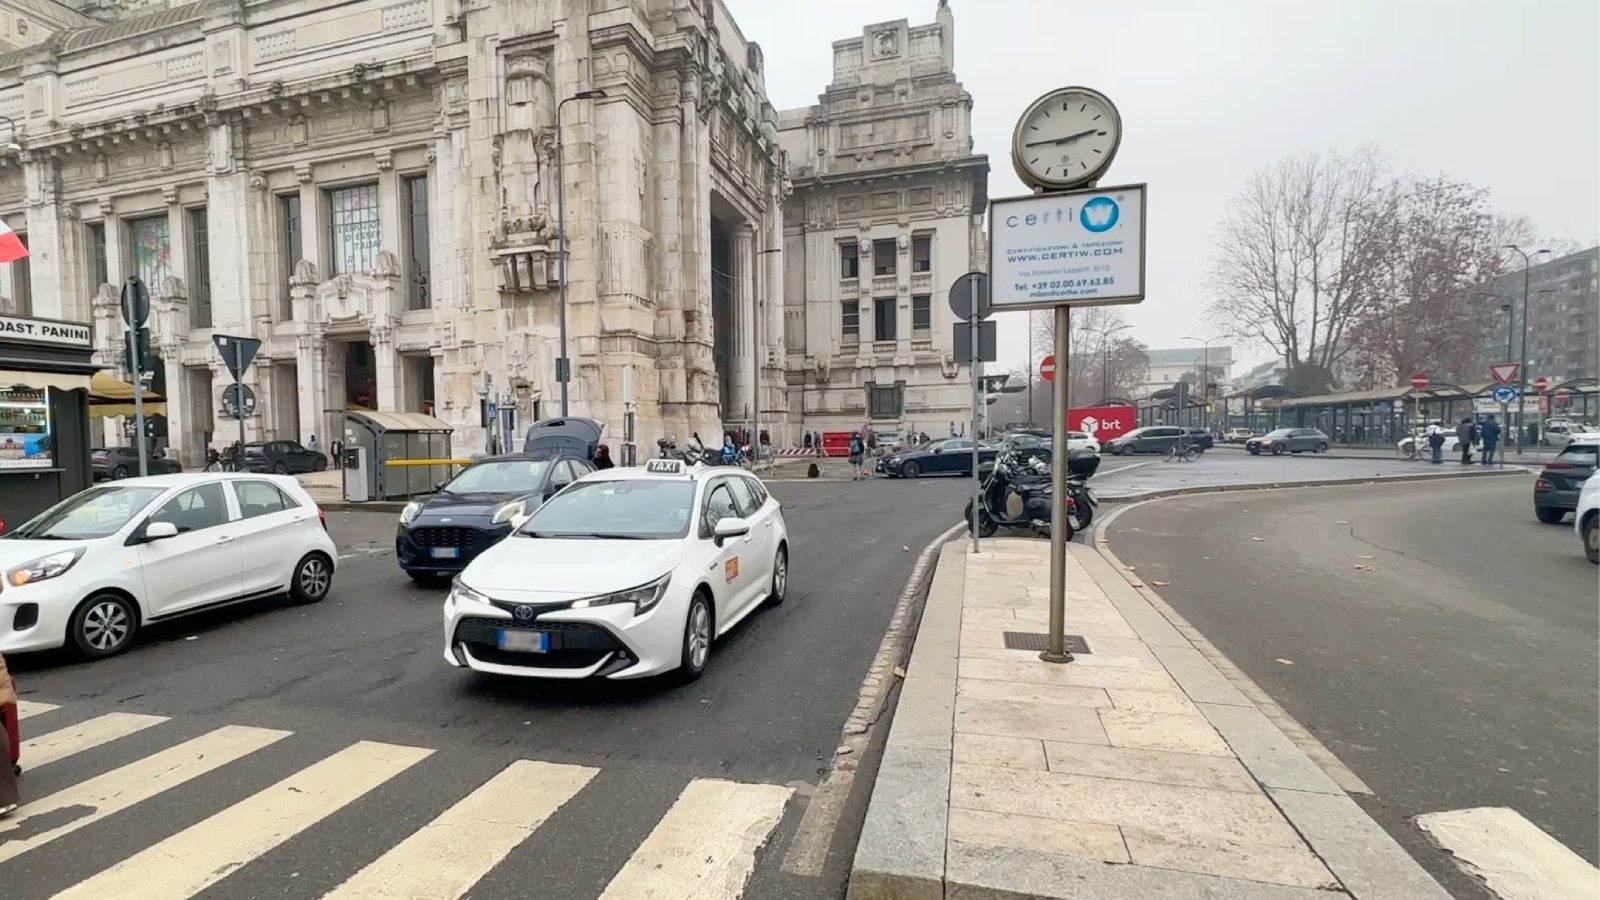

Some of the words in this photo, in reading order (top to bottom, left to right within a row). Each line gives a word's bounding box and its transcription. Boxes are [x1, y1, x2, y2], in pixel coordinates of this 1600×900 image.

[1007, 247, 1123, 263] WWW.CERTIW.COM
[1032, 281, 1048, 290] +39
[42, 325, 88, 340] PANINI
[1101, 418, 1121, 430] brt
[651, 461, 678, 472] TAXI
